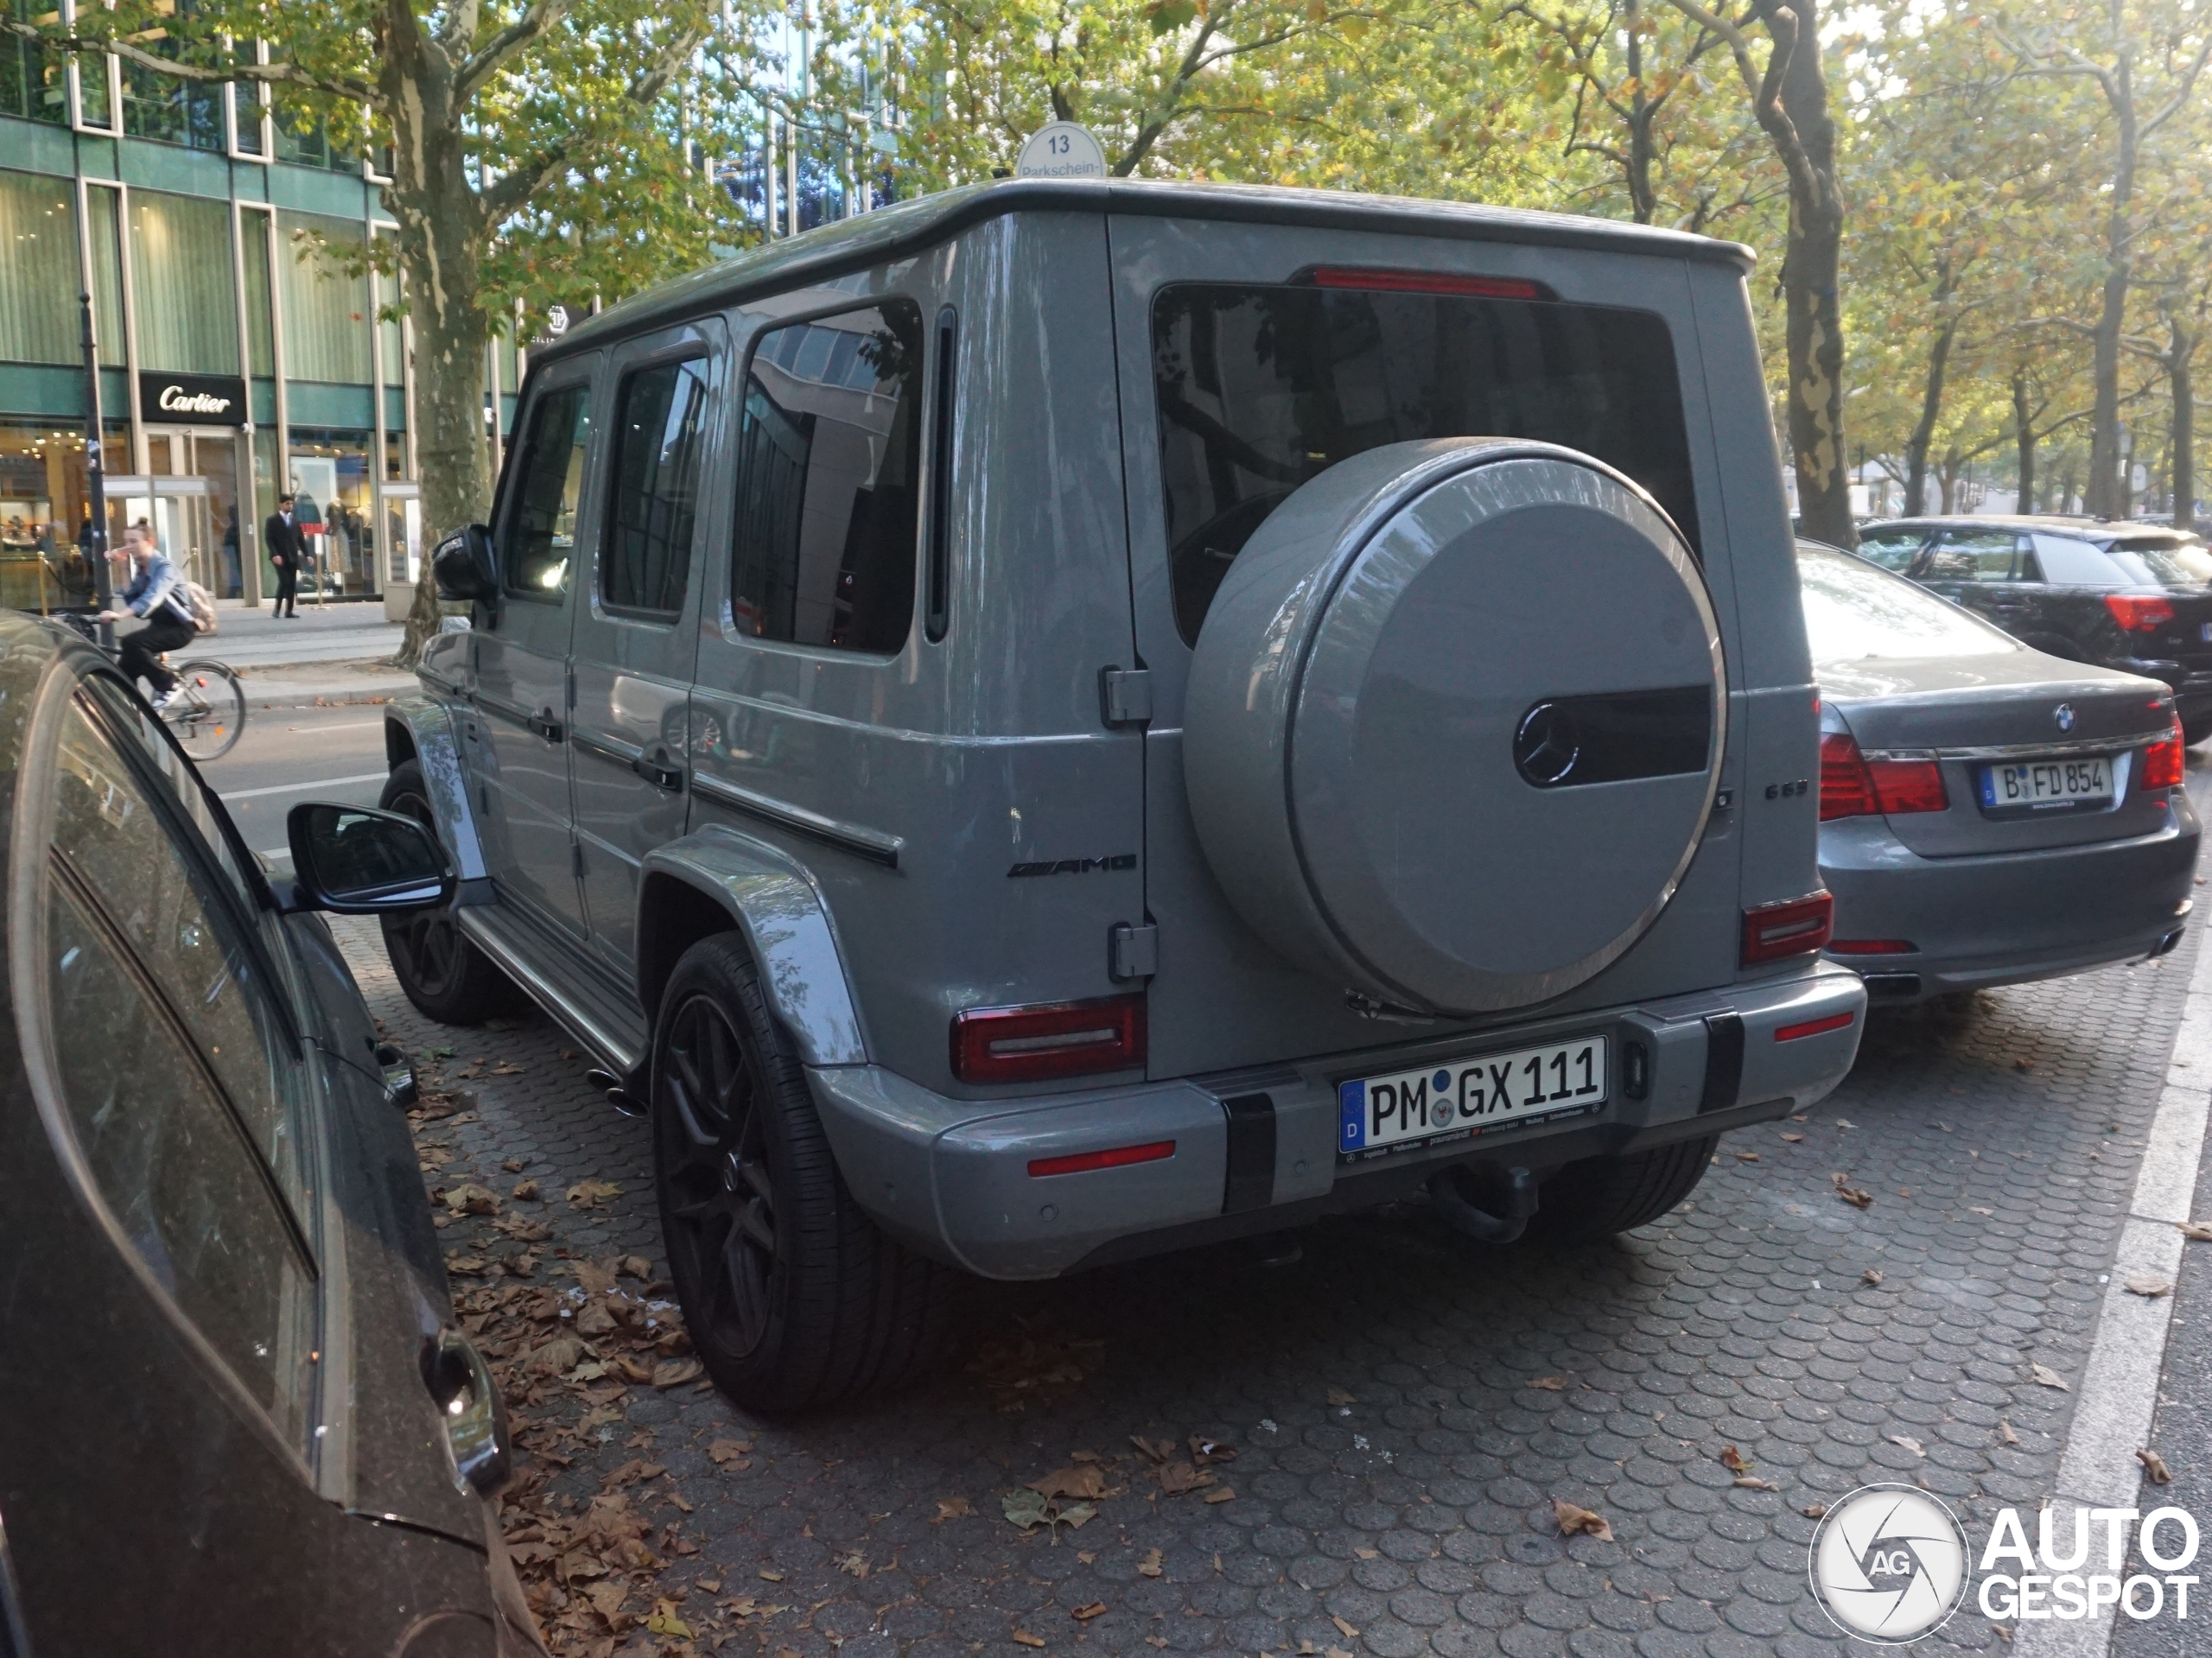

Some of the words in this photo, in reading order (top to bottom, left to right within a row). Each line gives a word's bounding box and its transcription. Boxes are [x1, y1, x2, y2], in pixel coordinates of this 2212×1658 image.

[1048, 134, 1070, 154] 13
[160, 385, 231, 413] Cartier
[2004, 768, 2019, 798] B
[2033, 765, 2062, 797] FD
[2066, 761, 2103, 793] 854
[1370, 1077, 1427, 1136] PM
[1459, 1061, 1512, 1118] GX
[1523, 1046, 1598, 1106] 111
[1347, 1124, 1357, 1138] D
